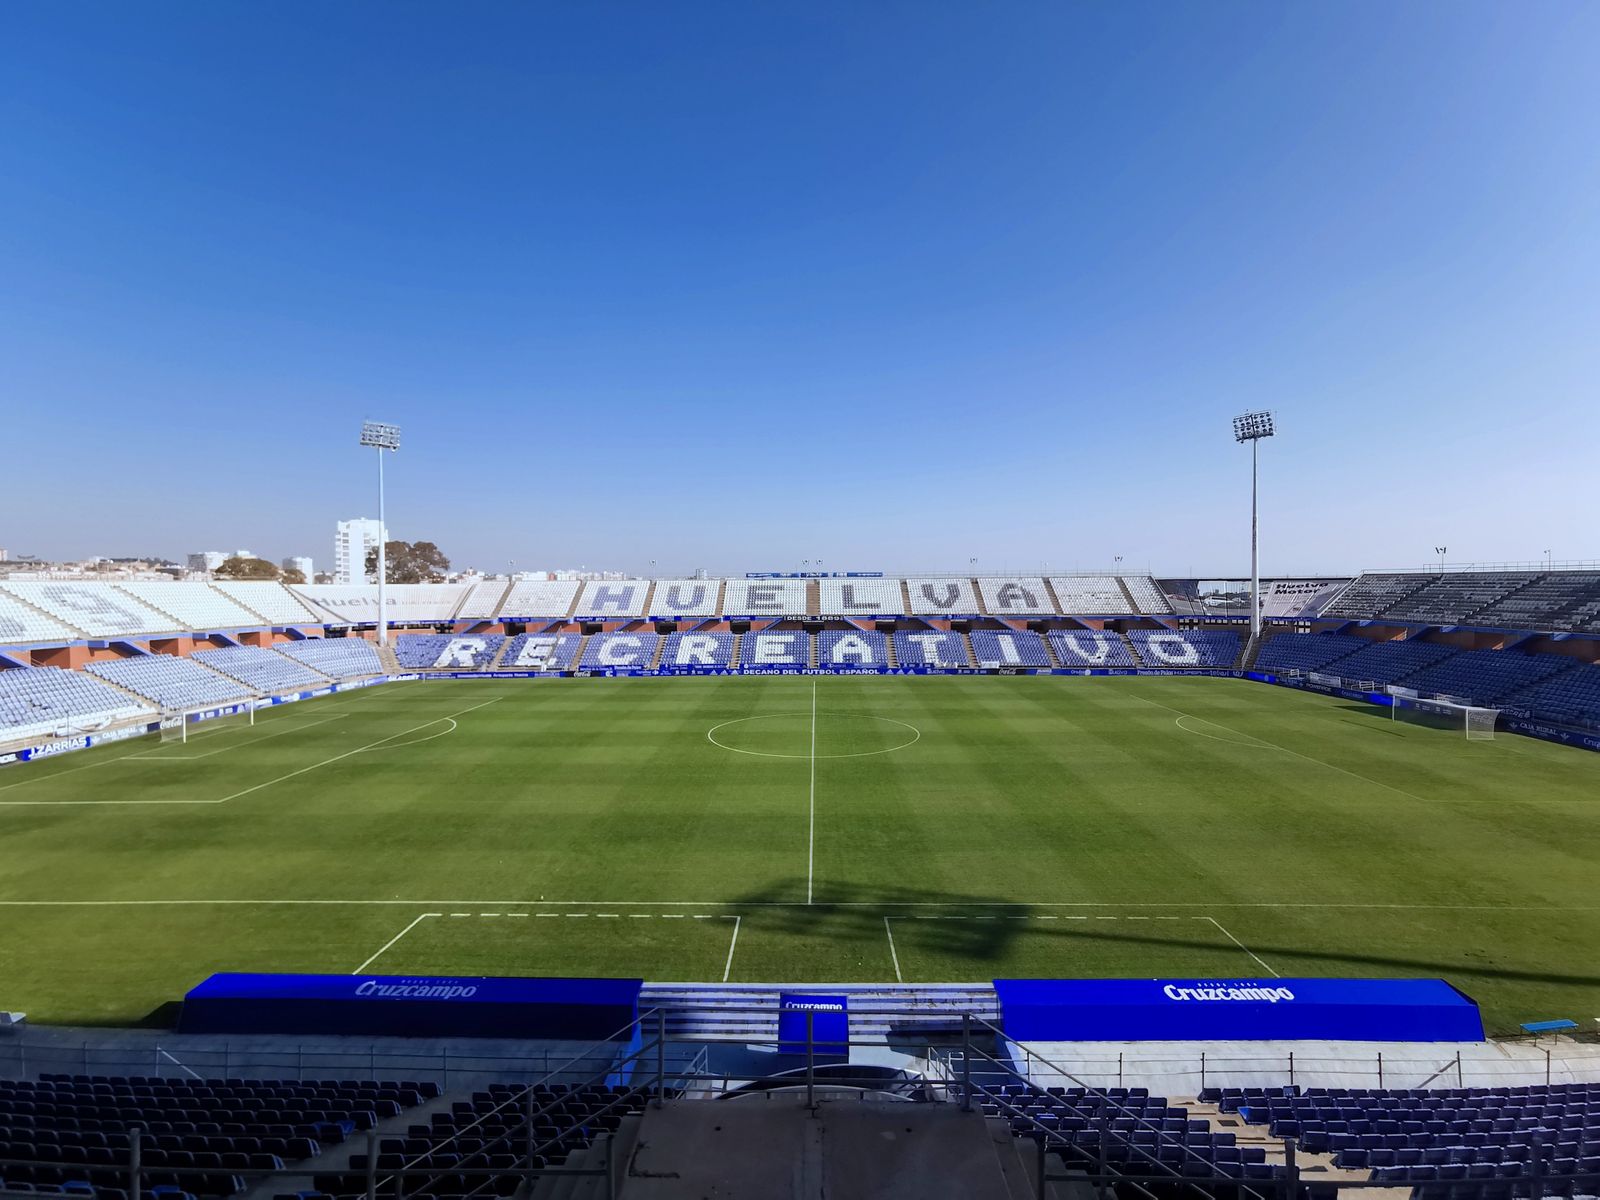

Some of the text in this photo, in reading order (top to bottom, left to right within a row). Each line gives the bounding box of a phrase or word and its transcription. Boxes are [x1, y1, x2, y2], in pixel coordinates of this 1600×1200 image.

[1276, 581, 1329, 590] Huelva
[590, 582, 1039, 612] HUELVA
[432, 633, 1203, 668] RECREATIVO
[839, 667, 880, 675] ESPAÑOL
[1519, 721, 1535, 731] CAJA
[1535, 724, 1558, 735] RURAL
[28, 736, 88, 757] J.ZARRIAS
[355, 980, 479, 999] Cruzcampo
[1163, 984, 1295, 1003] Cruzcampo
[785, 1001, 843, 1011] Cruzcampo
